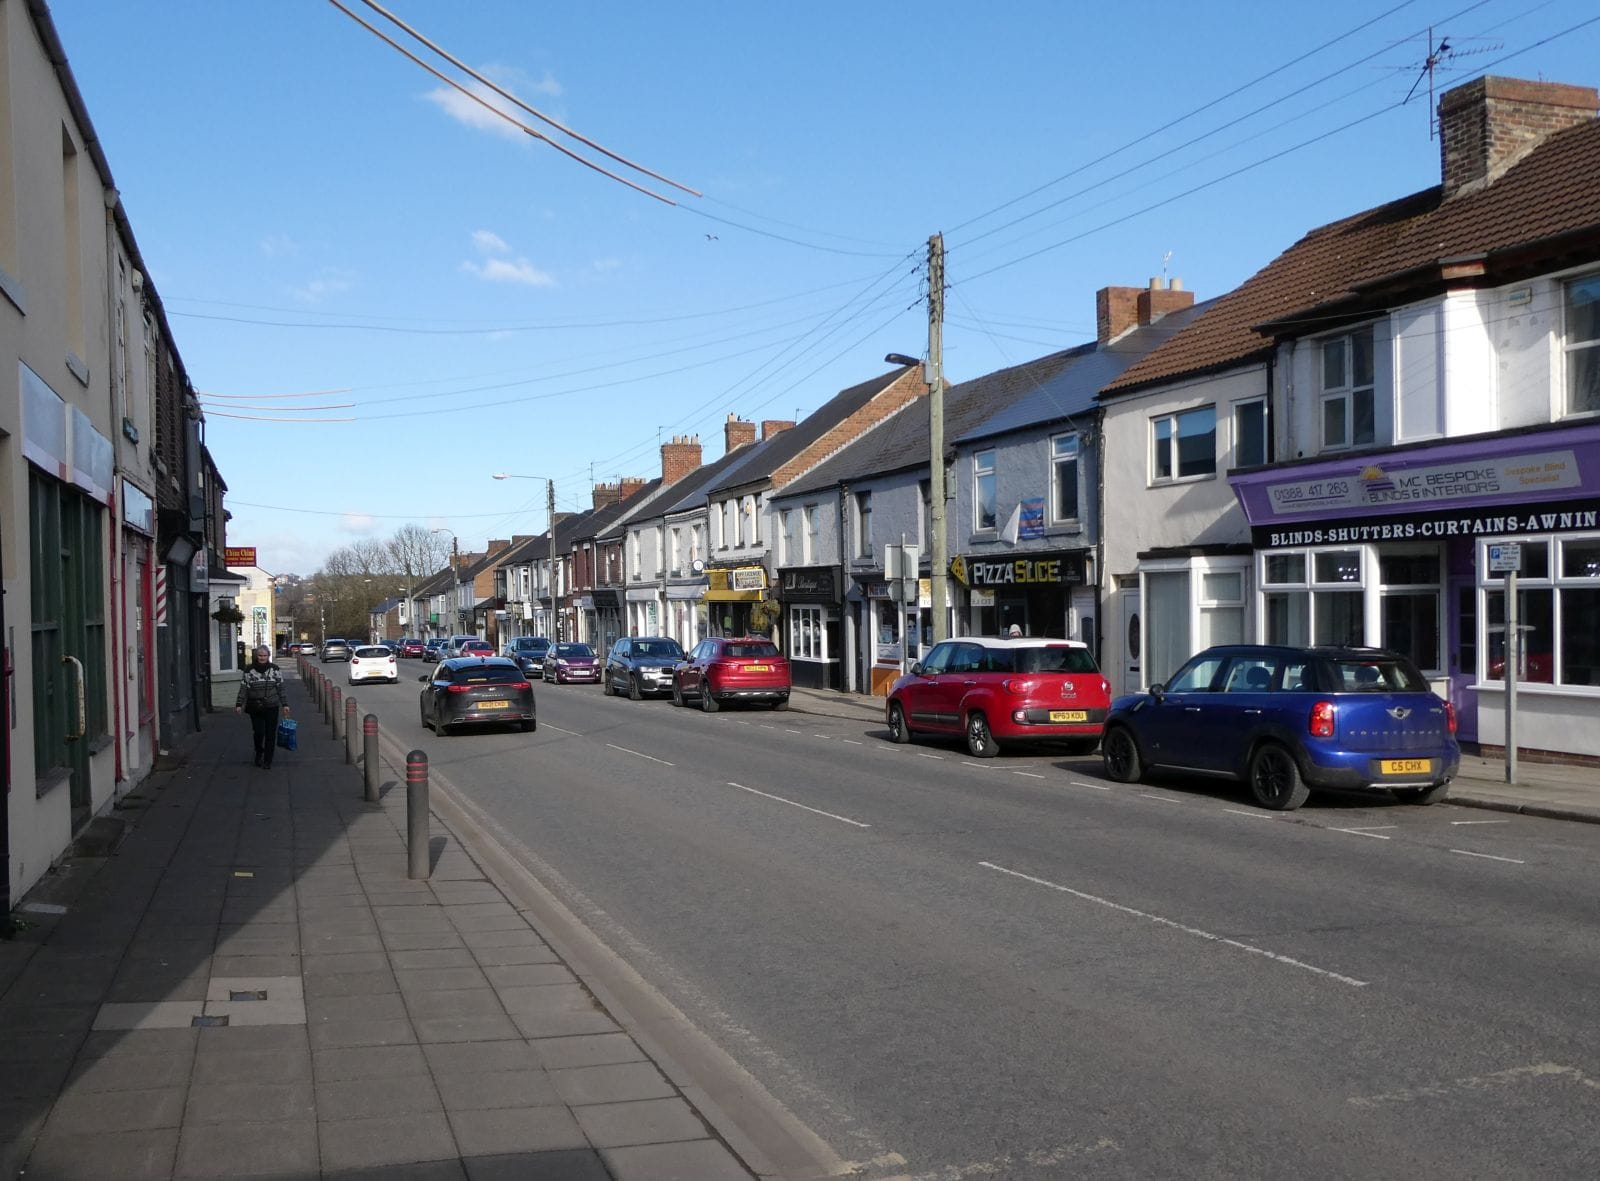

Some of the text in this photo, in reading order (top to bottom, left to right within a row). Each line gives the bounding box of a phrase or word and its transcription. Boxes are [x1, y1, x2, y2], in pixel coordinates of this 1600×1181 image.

[1399, 468, 1497, 489] MC BESPOKE
[1274, 481, 1349, 501] 01388 417 263
[1369, 489, 1410, 503] BLINDS
[1422, 480, 1500, 497] INTERIORS
